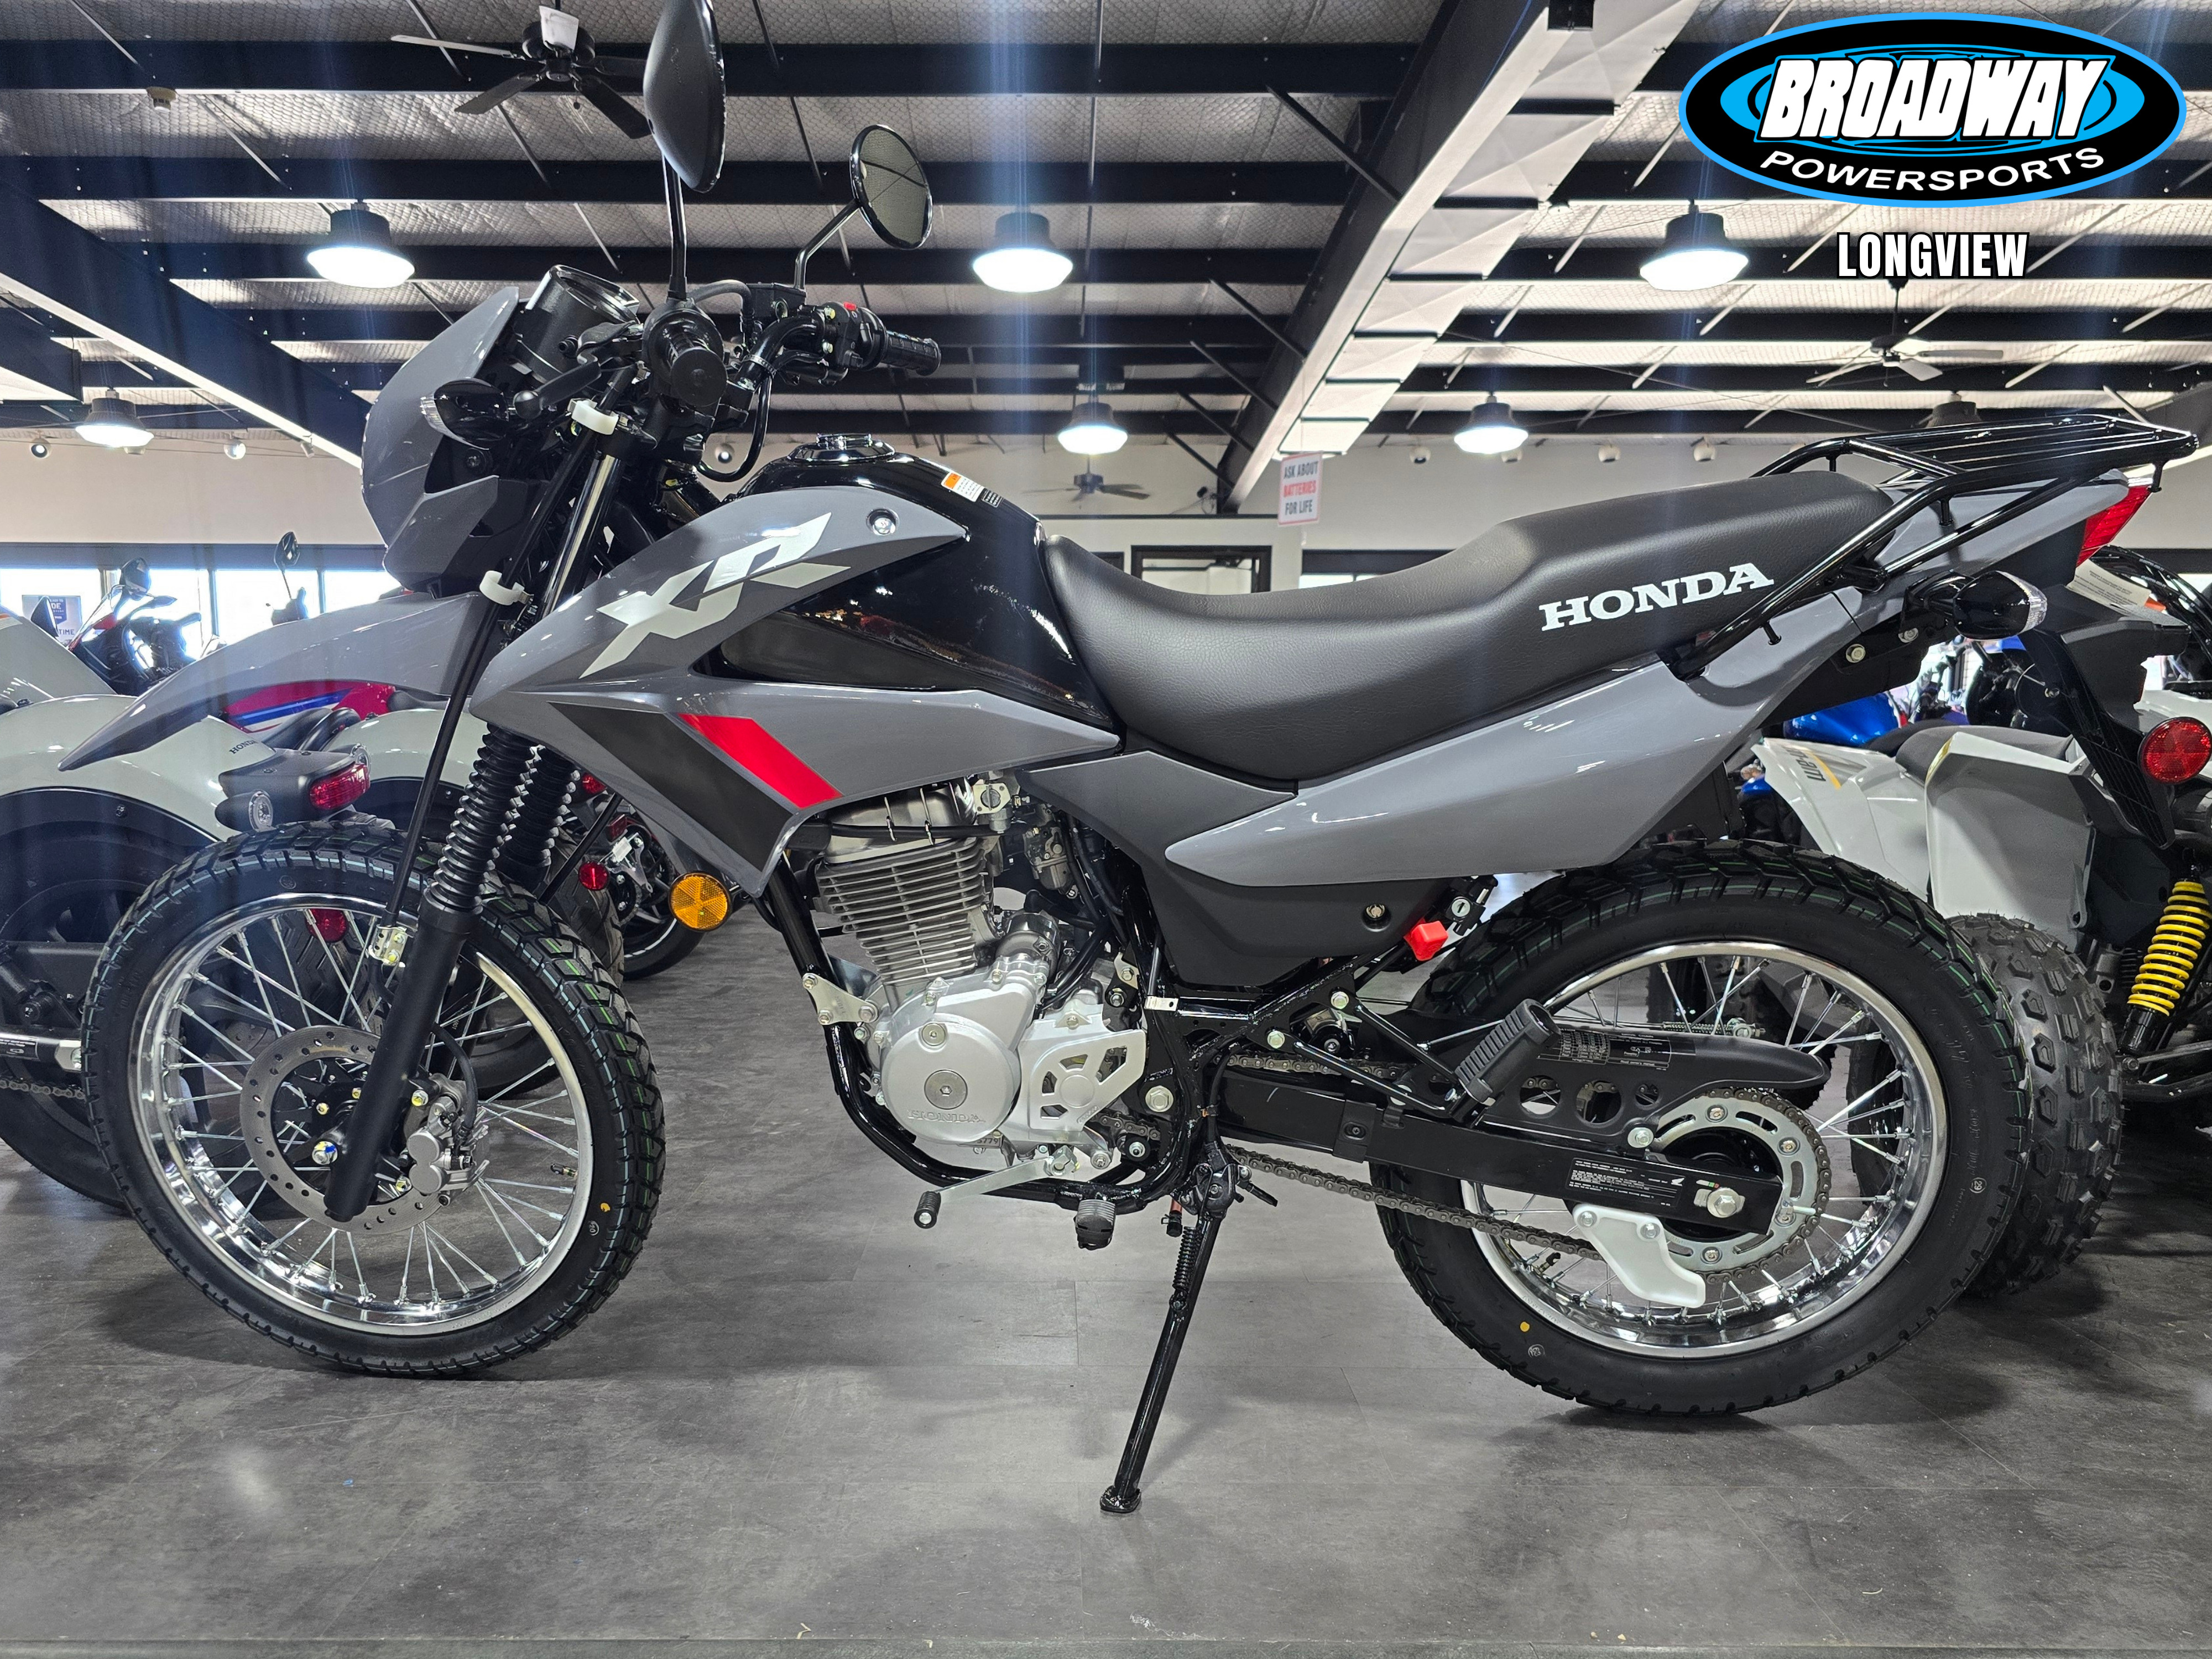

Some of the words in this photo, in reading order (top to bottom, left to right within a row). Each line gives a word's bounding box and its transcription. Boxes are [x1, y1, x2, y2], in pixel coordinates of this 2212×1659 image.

[1284, 465, 1296, 479] ASK
[1297, 461, 1318, 477] ABOUT
[1284, 480, 1316, 497] BATTERIES
[1285, 502, 1297, 515] FOR
[1299, 499, 1313, 513] LIFE
[1538, 562, 1775, 632] HONDA
[907, 1109, 987, 1123] HONDA
